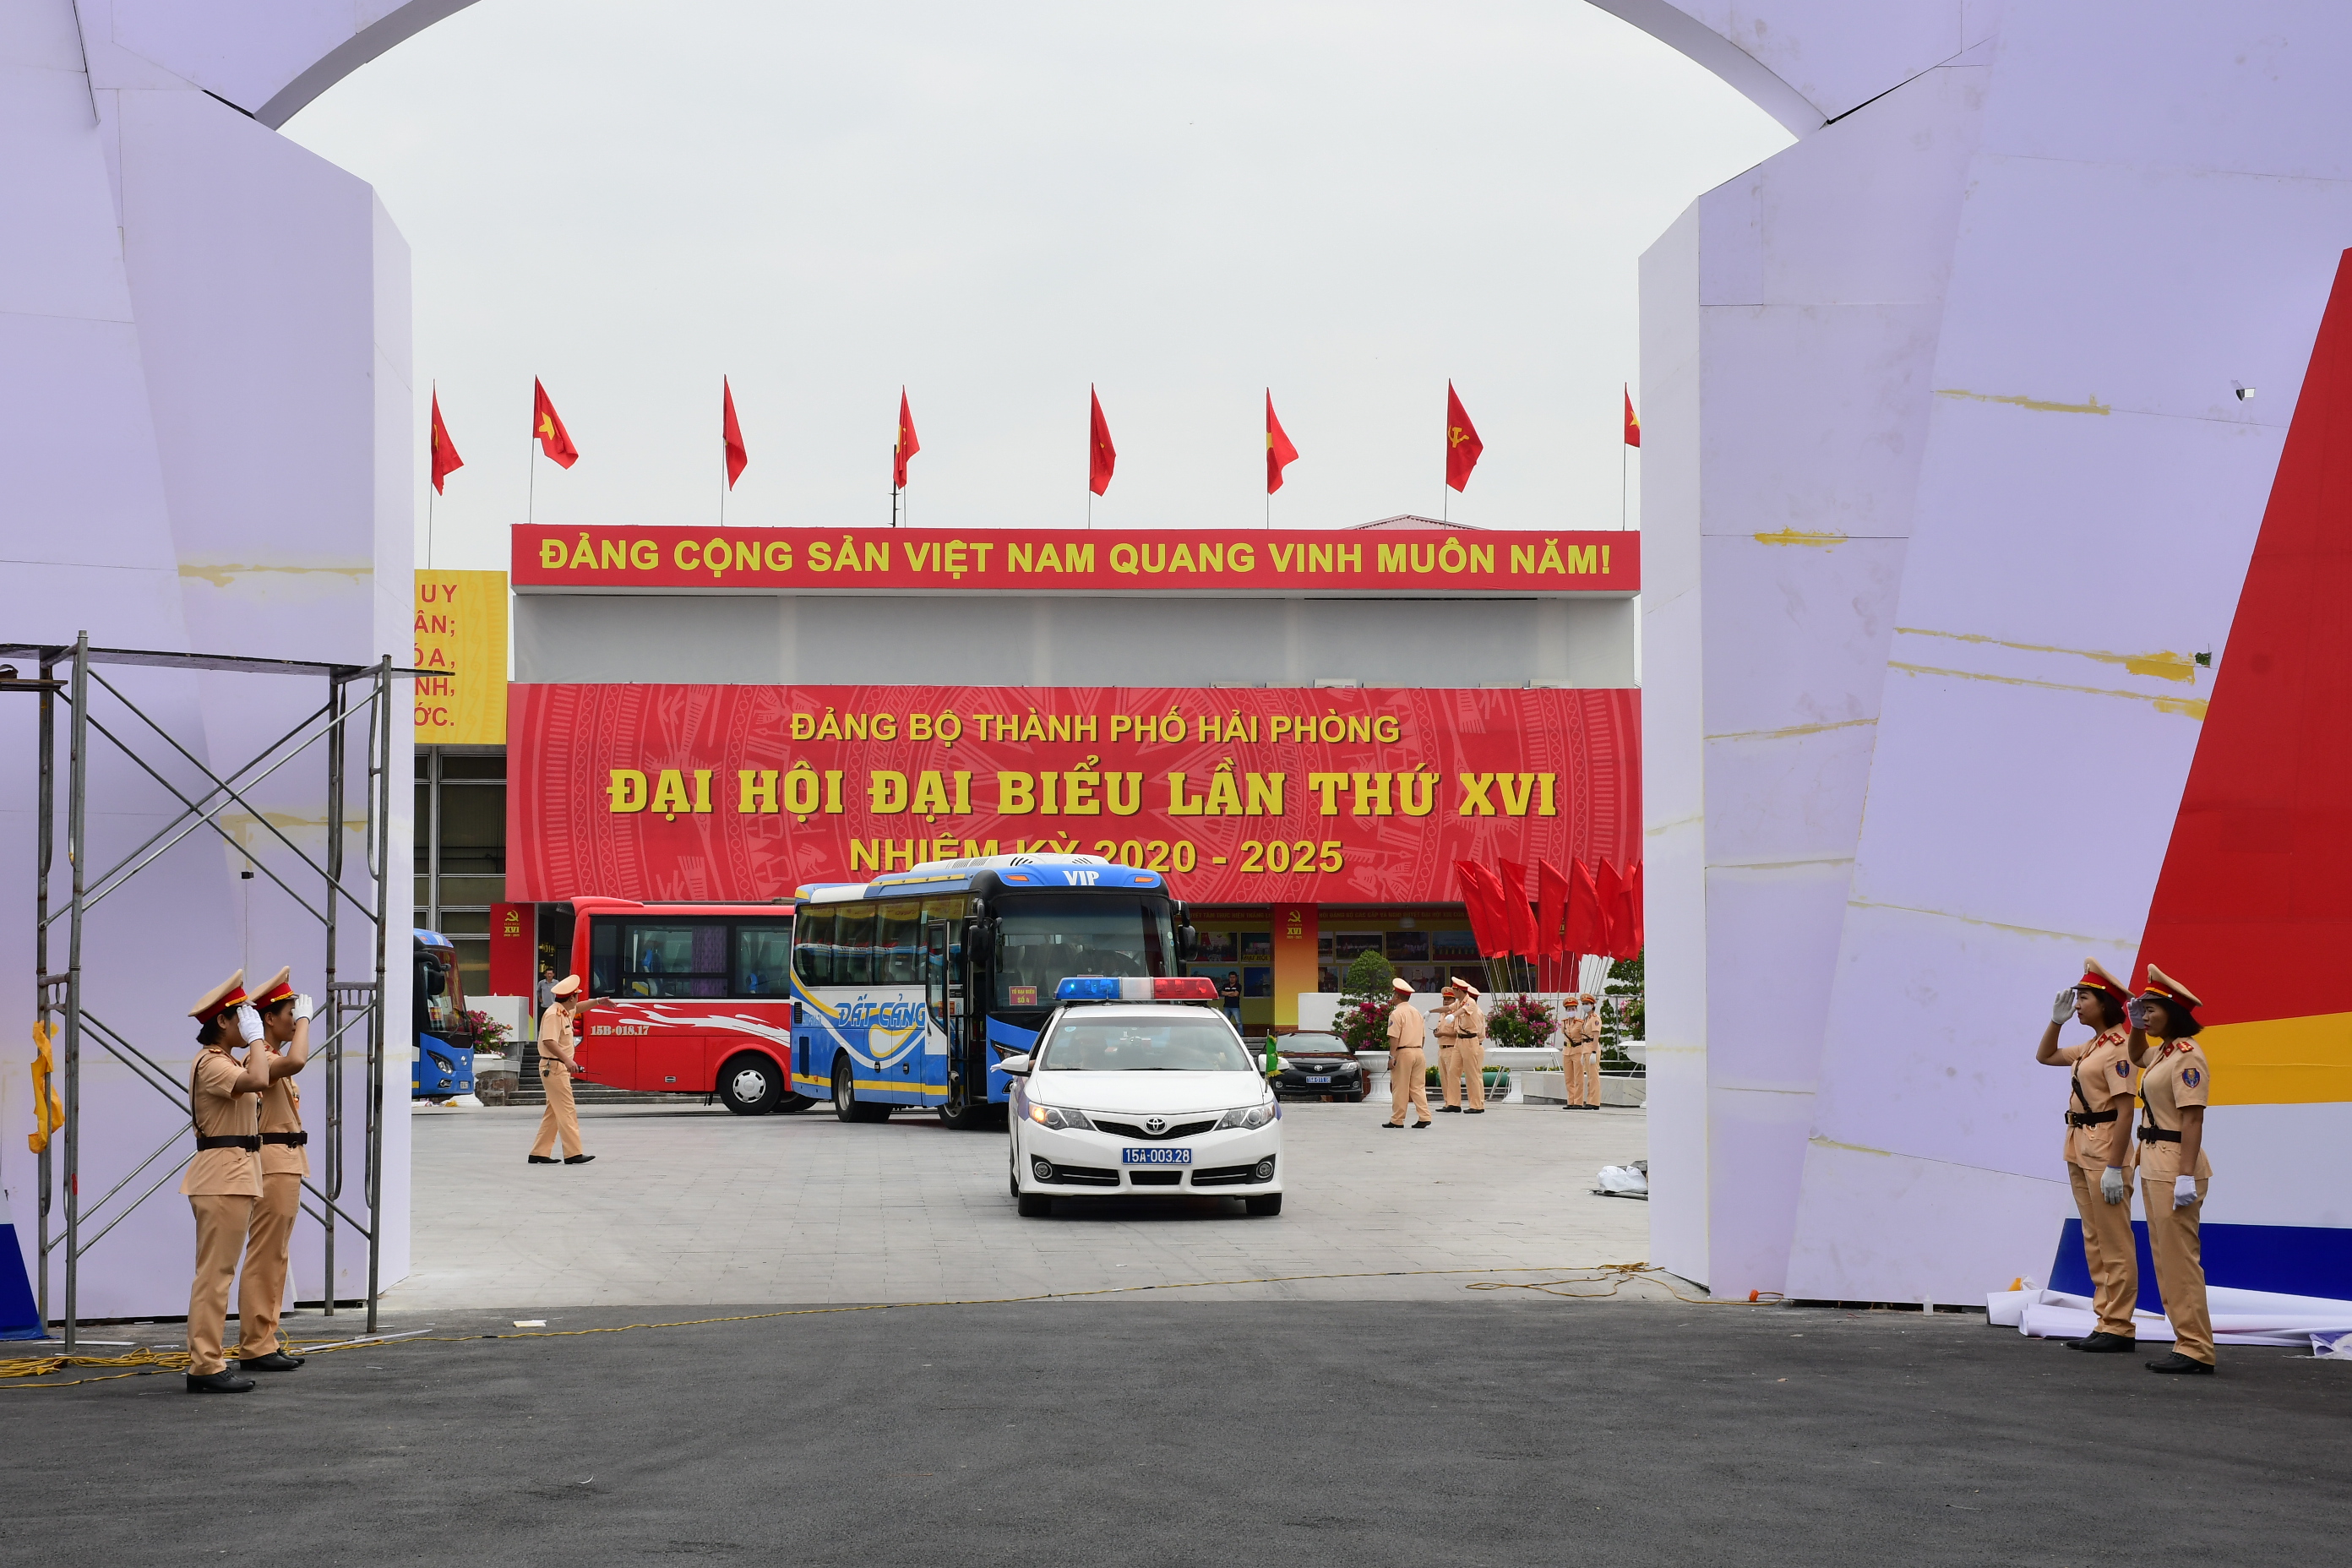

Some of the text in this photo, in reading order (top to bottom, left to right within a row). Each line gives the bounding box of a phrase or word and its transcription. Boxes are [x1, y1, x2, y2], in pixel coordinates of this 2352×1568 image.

[540, 532, 1610, 580] ĐẢNG CỘNG SẢN VIỆT NAM QUANG VINH MUÔN NĂM!
[415, 584, 458, 603] UY
[415, 609, 455, 638] ÂN;
[415, 642, 455, 668] ÓA,
[415, 677, 455, 697] NH,
[415, 701, 455, 727] ỚC.
[790, 705, 1400, 748] ĐẢNG BỘ THÀNH PHỐ HẢI PHÒNG
[607, 754, 1556, 823] ĐẠI HỘI ĐẠI BIỂU LẦN THỨ XVI
[851, 831, 999, 871] NHIỆM
[1093, 840, 1196, 873] 2020
[1239, 840, 1343, 873] 2025
[1062, 870, 1099, 886] VIP
[835, 994, 926, 1028] ĐẤT CẢNG
[591, 1025, 651, 1036] 15B-018.17
[1125, 1149, 1190, 1163] 15A-003.28
